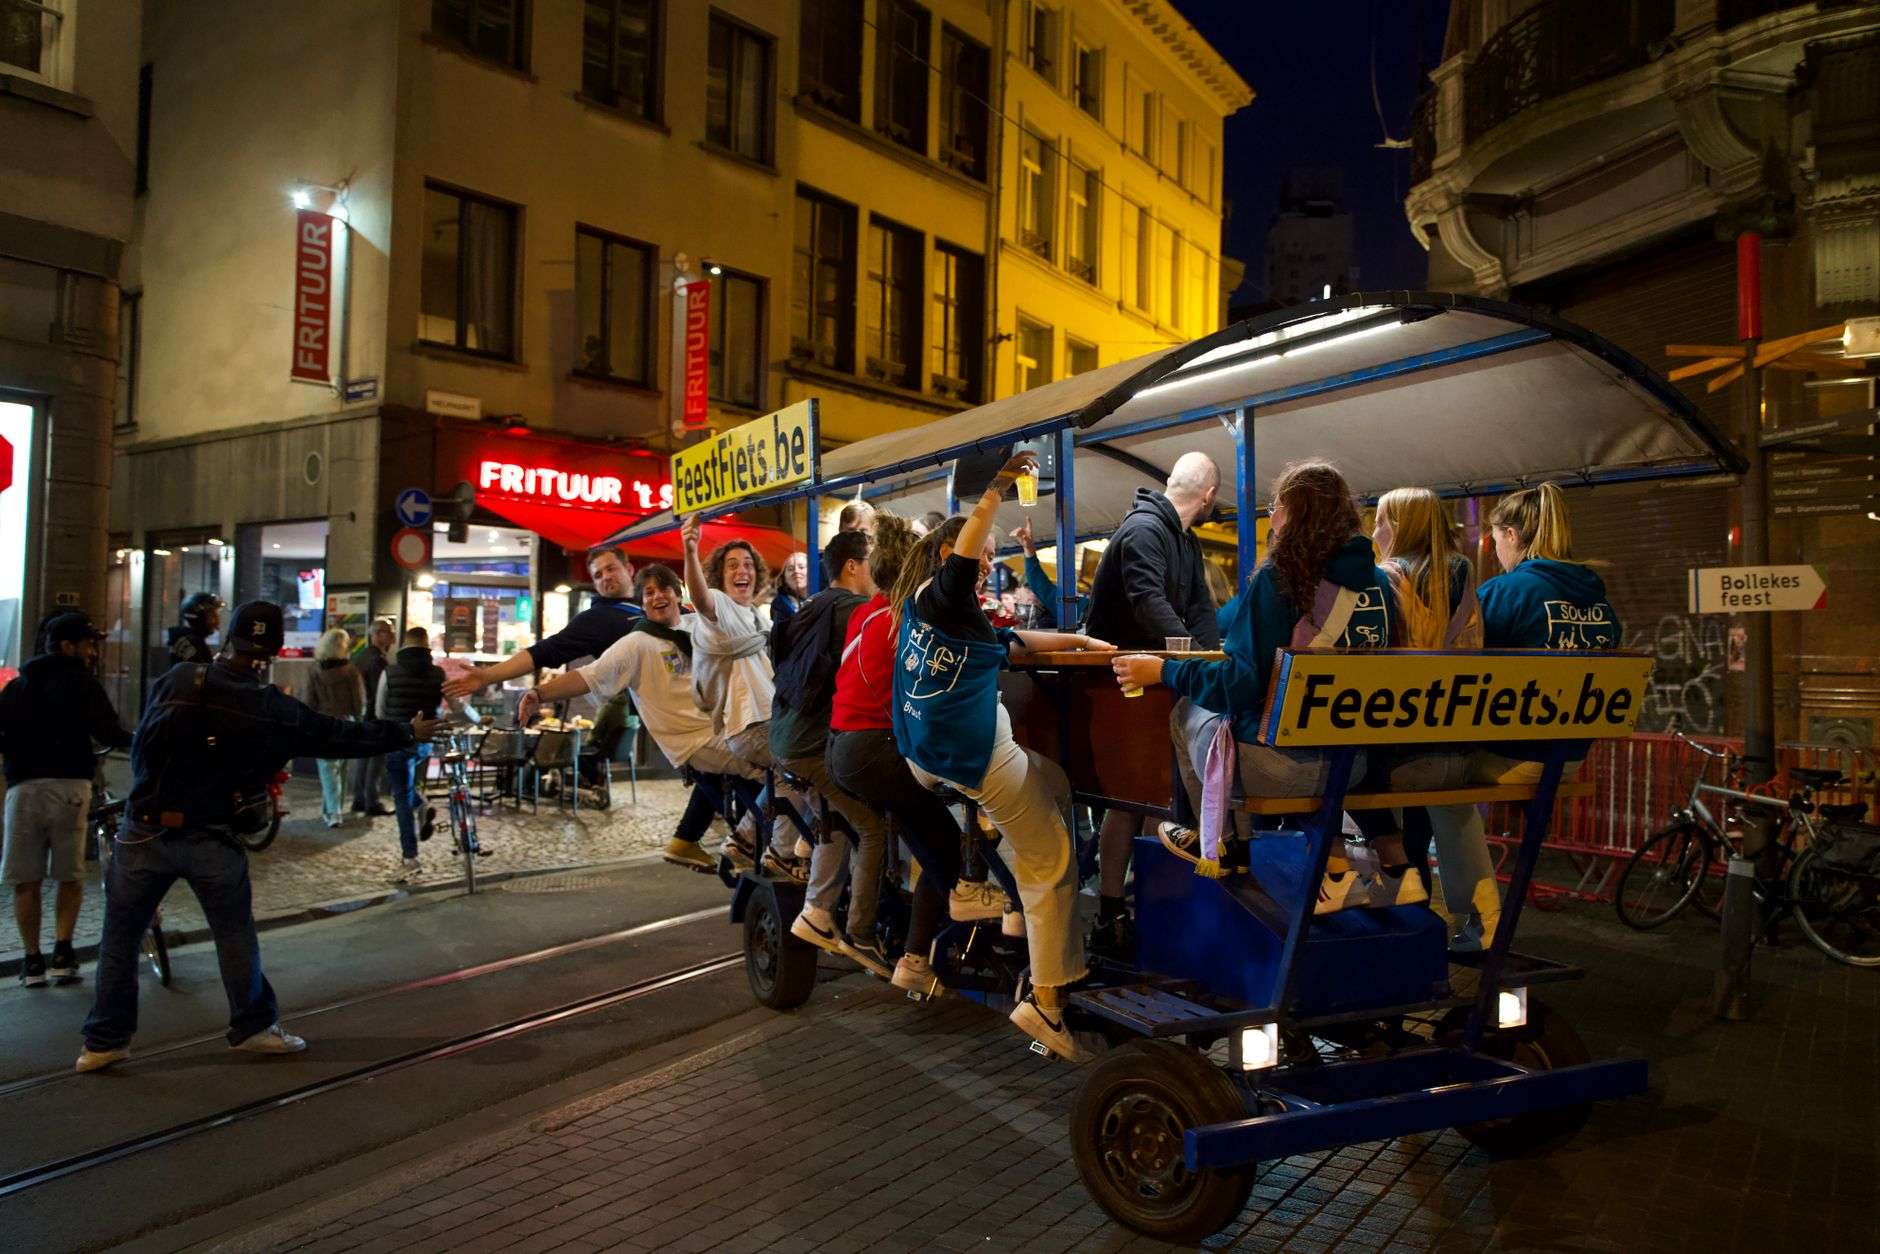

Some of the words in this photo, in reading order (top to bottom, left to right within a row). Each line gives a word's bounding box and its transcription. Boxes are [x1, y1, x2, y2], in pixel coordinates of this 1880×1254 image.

[298, 222, 330, 372] FRITUUR
[687, 288, 706, 414] FRITUUR
[479, 460, 622, 504] FRITUUR
[675, 414, 805, 513] FeestFiets.be
[1720, 573, 1800, 591] Bollekes
[1721, 592, 1772, 607] feest
[1296, 672, 1633, 730] FeestFiets.be
